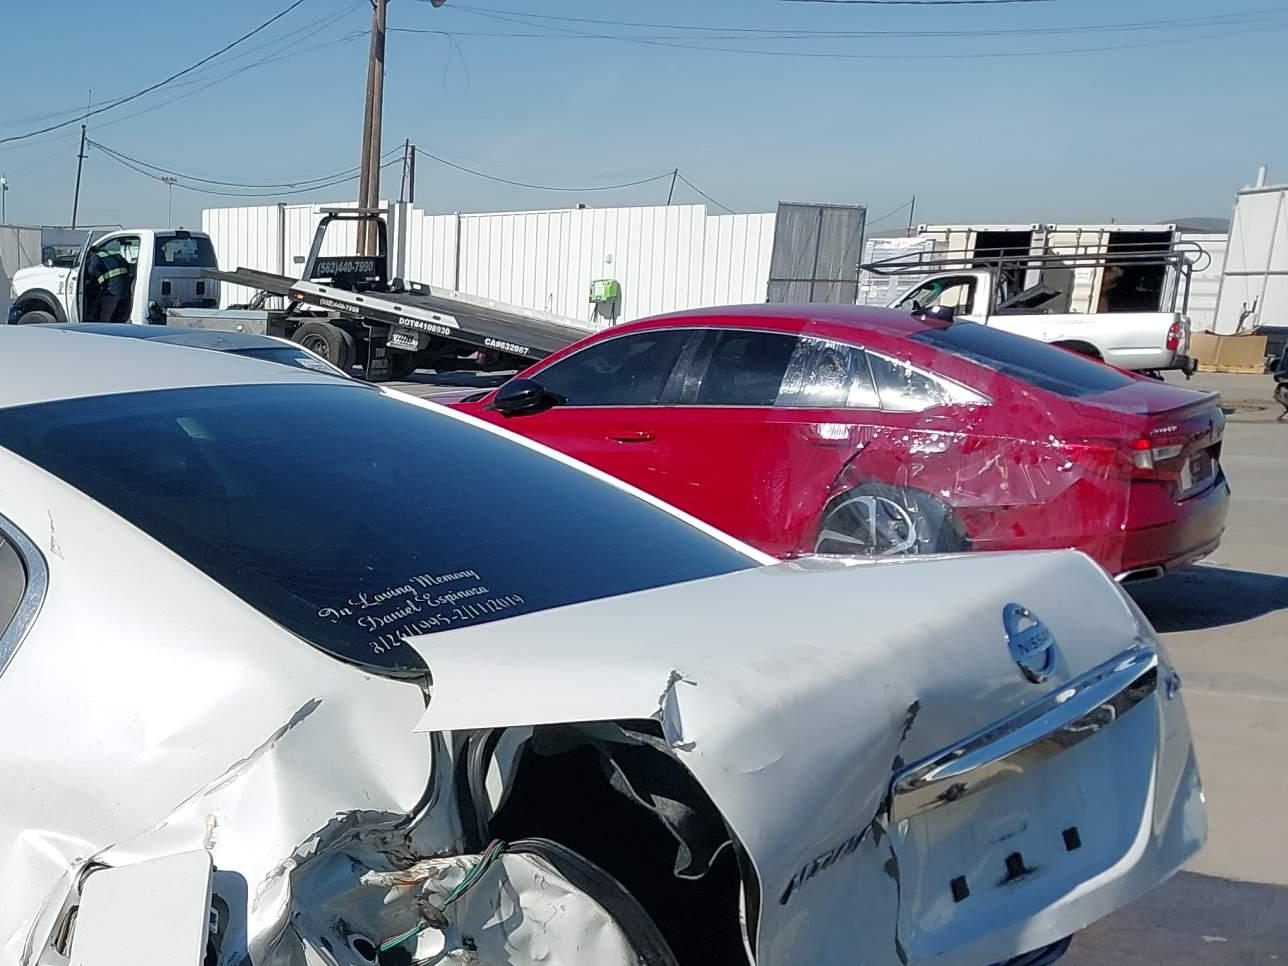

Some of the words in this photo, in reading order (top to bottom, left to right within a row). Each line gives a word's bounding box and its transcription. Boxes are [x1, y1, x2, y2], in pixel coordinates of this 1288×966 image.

[318, 607, 352, 623] In
[348, 585, 418, 609] Loving
[409, 569, 481, 588] Memory
[357, 599, 422, 632] Daniel
[414, 585, 490, 607] Espinoza
